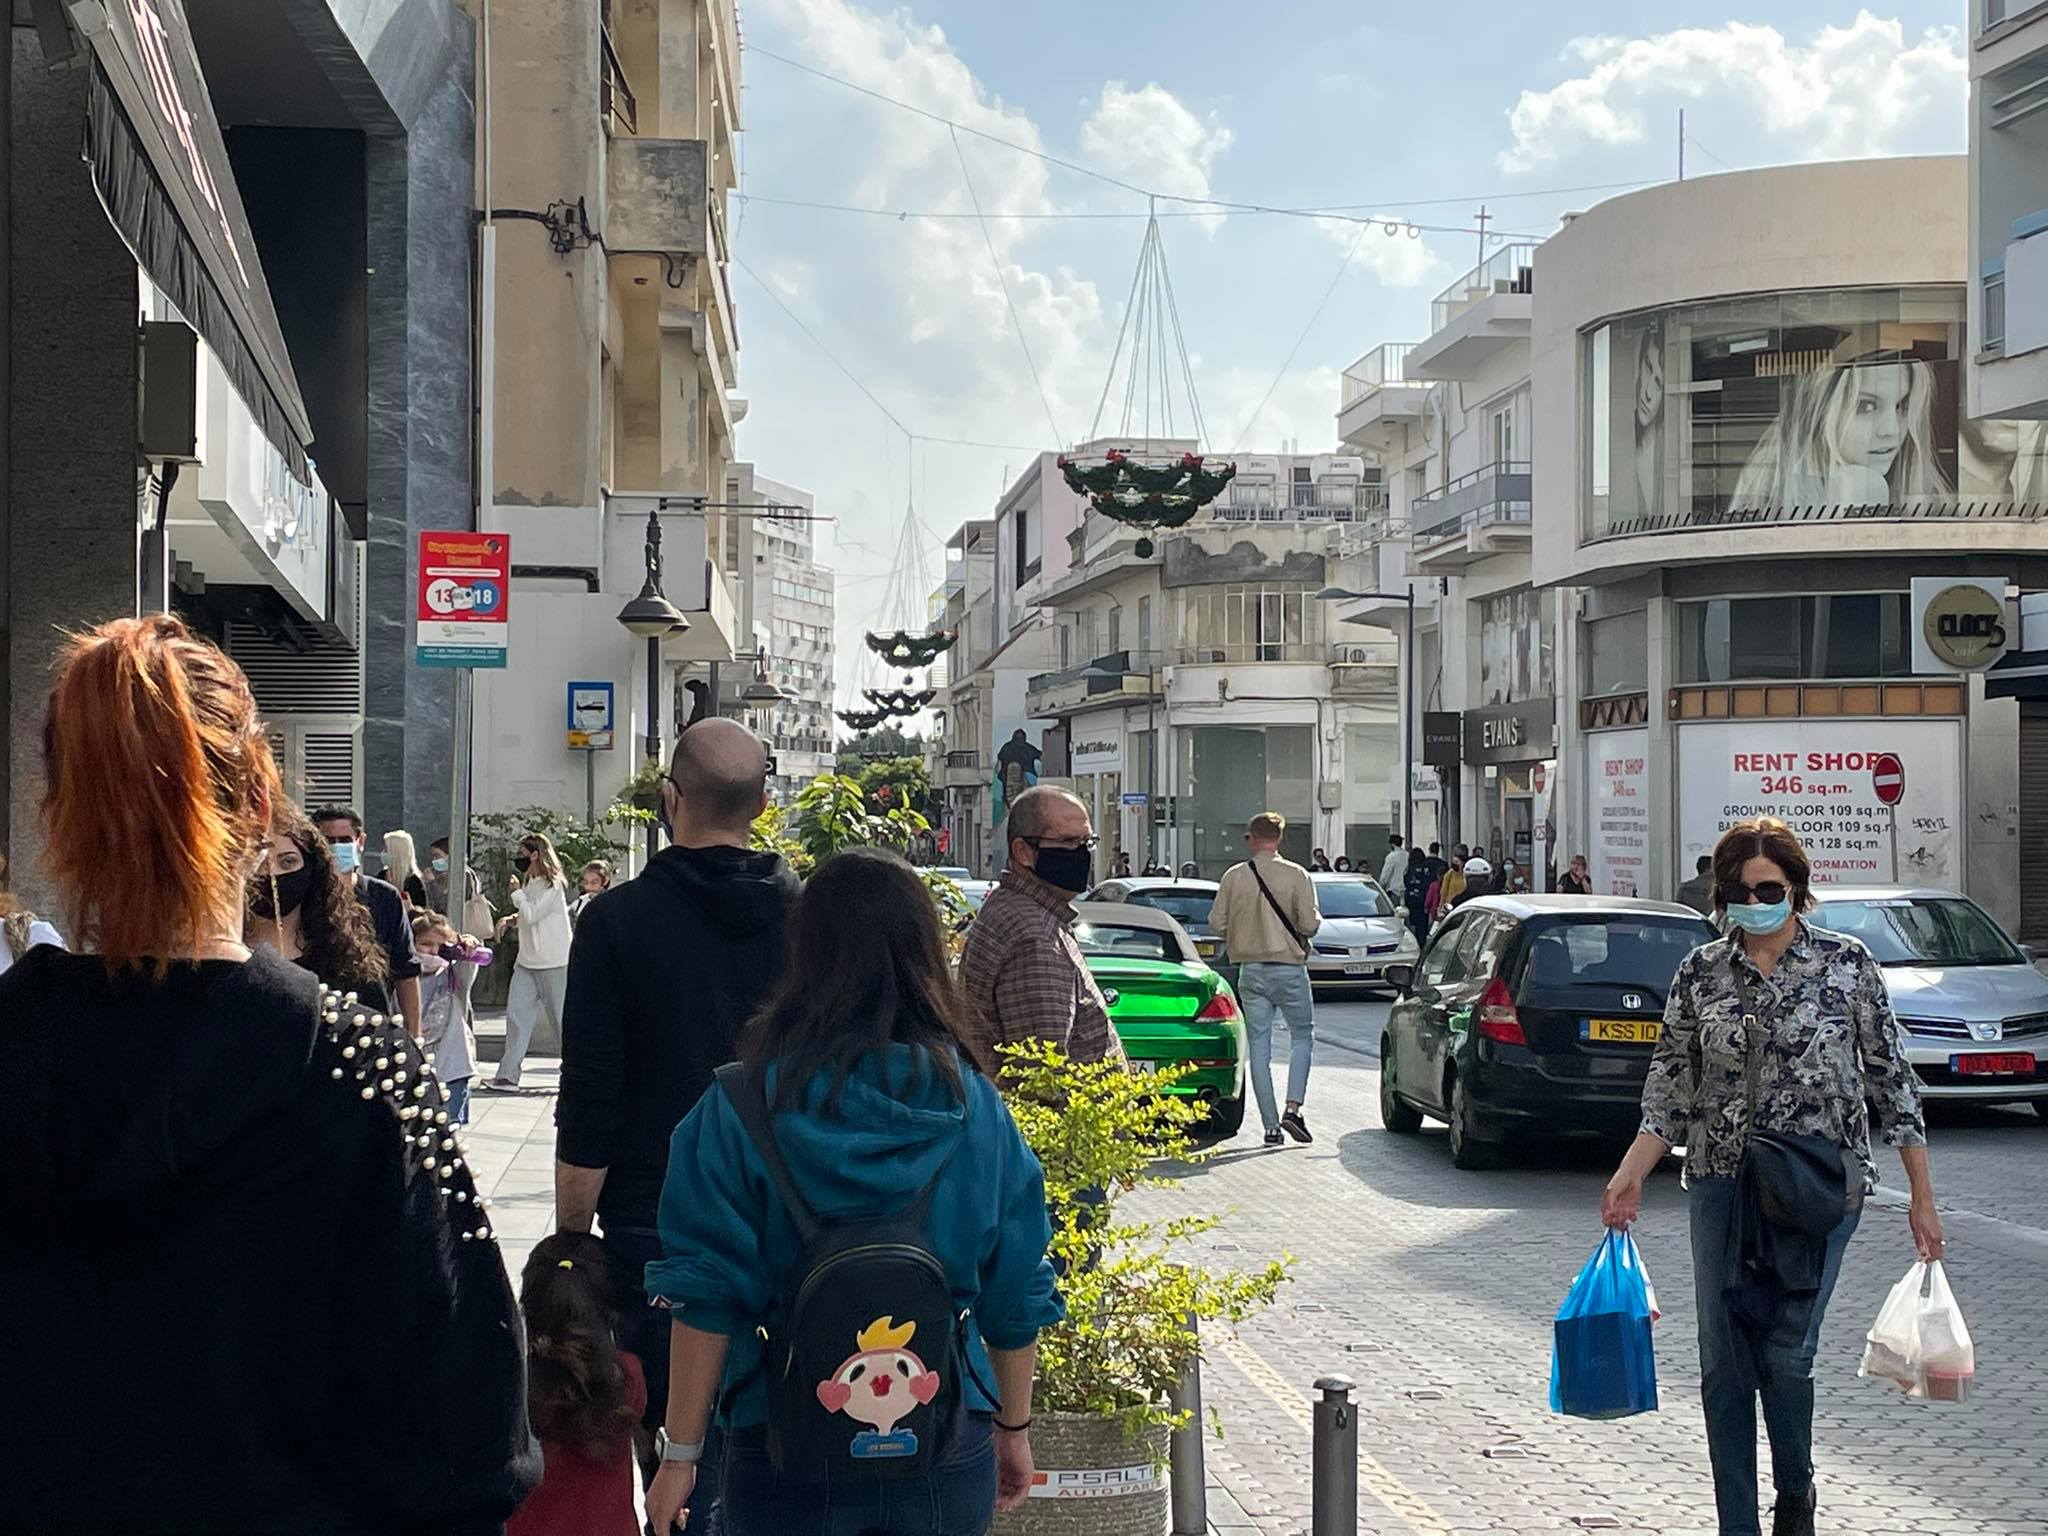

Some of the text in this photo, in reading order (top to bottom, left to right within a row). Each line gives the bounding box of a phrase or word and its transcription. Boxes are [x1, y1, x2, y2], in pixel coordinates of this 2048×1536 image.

[435, 589, 492, 604] 13 18
[1483, 716, 1519, 748] EVANS
[1734, 753, 1798, 772] RENT
[1761, 776, 1853, 796] 346 sq.m.
[1723, 805, 1775, 816] GROUND
[1779, 805, 1825, 816] FLOOR
[1830, 805, 1852, 816] 109
[1838, 821, 1860, 832] 109
[1819, 838, 1841, 849] 128
[1599, 1022, 1635, 1039] KSS
[1057, 1487, 1113, 1497] AUTO
